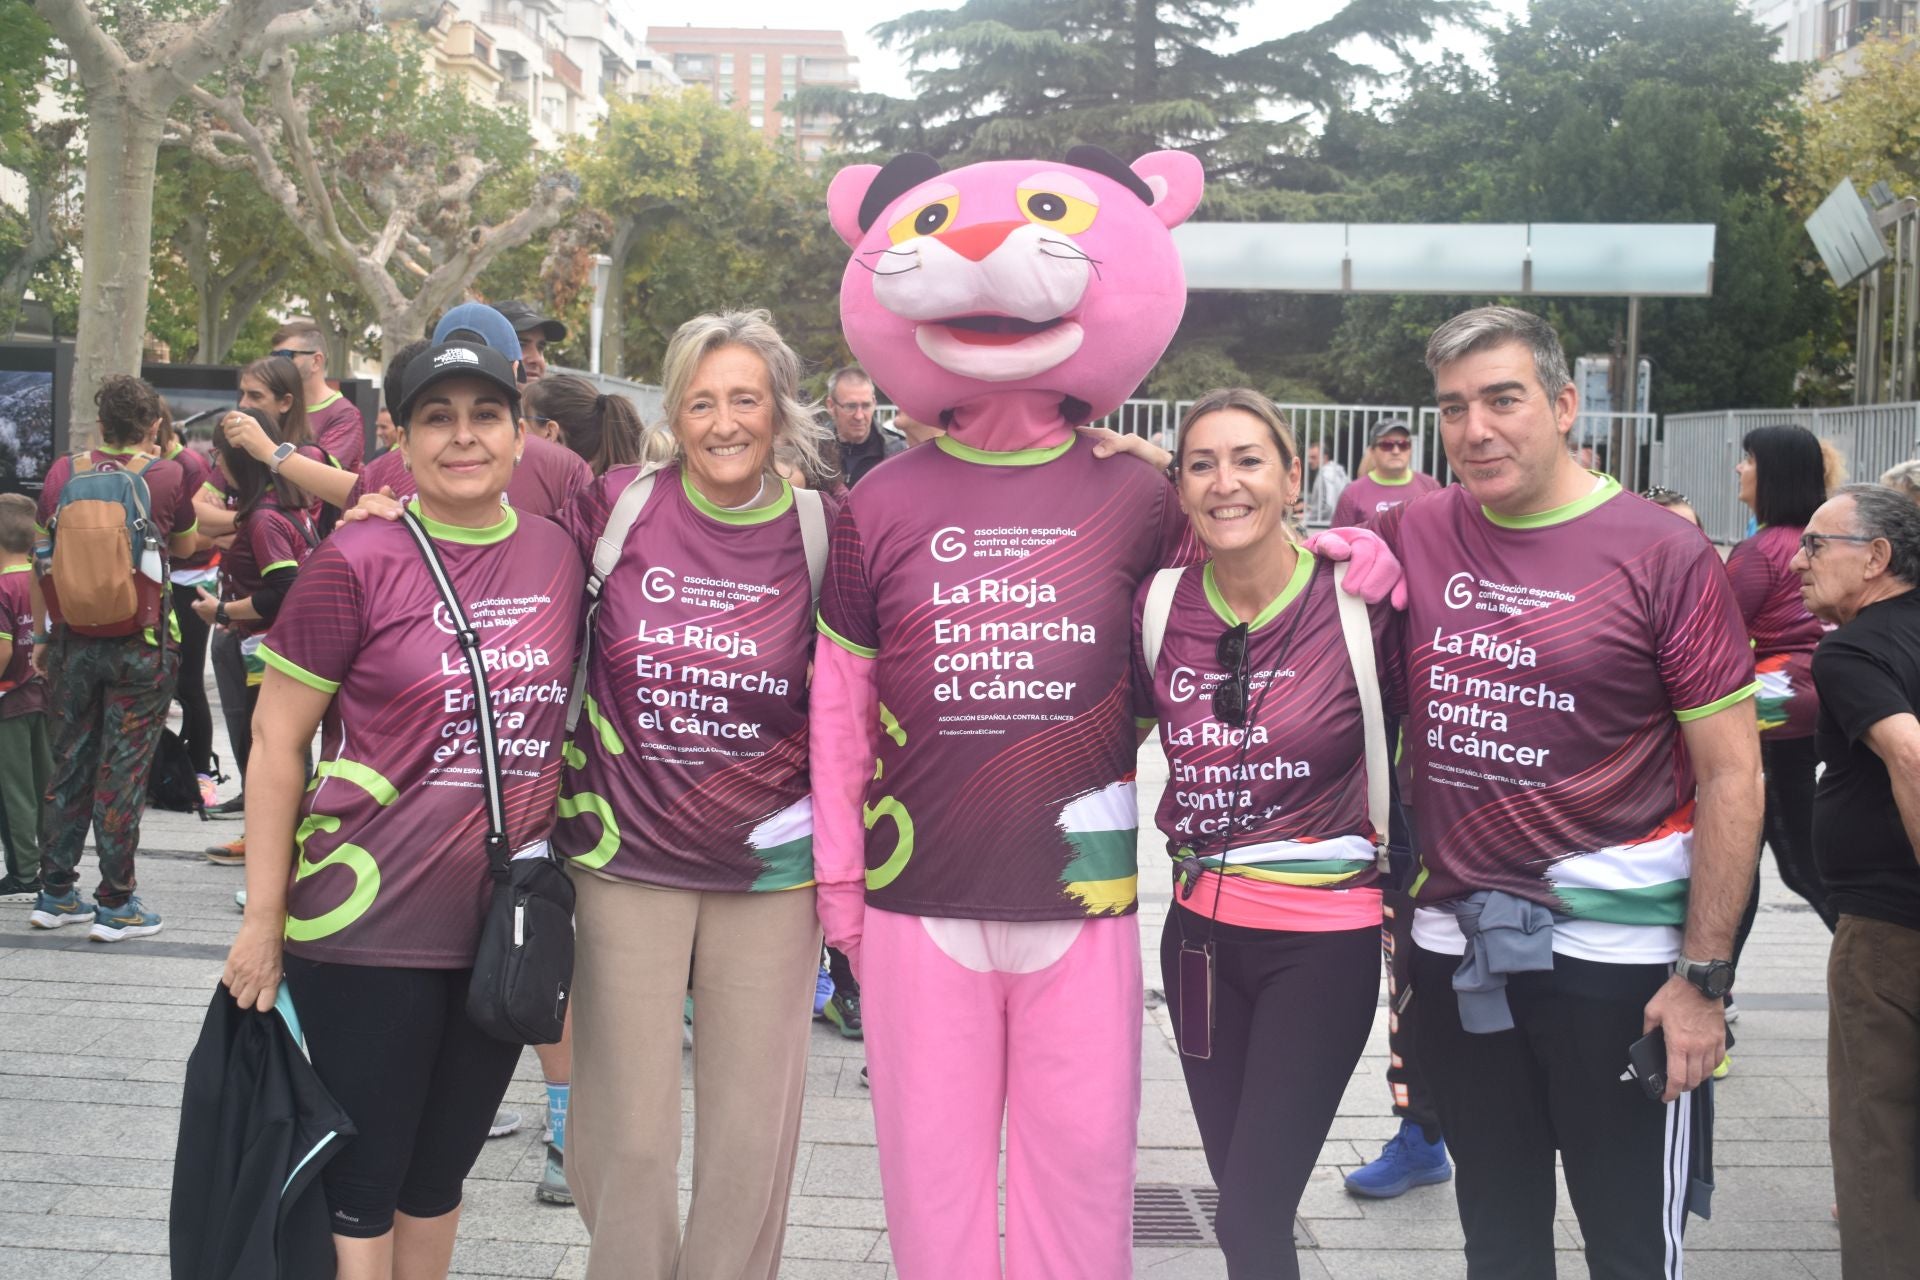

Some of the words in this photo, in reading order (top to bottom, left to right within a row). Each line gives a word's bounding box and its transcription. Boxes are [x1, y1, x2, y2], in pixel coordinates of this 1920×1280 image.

[974, 526, 1029, 536] asociación
[1031, 527, 1077, 537] española
[974, 538, 1008, 546] contra
[1010, 536, 1019, 546] el
[1021, 537, 1057, 546] cáncer
[989, 548, 1002, 557] La
[1004, 547, 1030, 559] Rioja
[681, 585, 715, 597] contra
[716, 588, 726, 598] el
[727, 591, 761, 603] cáncer
[683, 575, 736, 589] asociación
[737, 582, 780, 596] española
[933, 581, 970, 605] La
[980, 578, 1057, 608] Rioja
[1479, 579, 1527, 594] asociación
[1528, 588, 1576, 602] española
[473, 608, 496, 618] ontra
[507, 606, 538, 615] cáncer
[513, 595, 551, 605] española
[680, 597, 694, 605] en
[695, 597, 708, 607] La
[709, 599, 735, 612] Rioja
[1475, 602, 1487, 610] en
[1488, 603, 1498, 612] La
[1499, 603, 1523, 616] Rioja
[1478, 590, 1506, 602] contra
[1506, 594, 1517, 604] el
[1517, 597, 1551, 609] cáncer
[470, 621, 482, 629] en
[482, 620, 494, 628] La
[494, 618, 519, 627] Rioja
[934, 618, 971, 644] En
[980, 616, 1096, 644] marcha
[638, 619, 674, 645] La
[683, 625, 758, 659] Rioja
[1432, 626, 1463, 655] La
[1469, 633, 1537, 670] Rioja
[480, 644, 550, 672] Rioja
[934, 646, 1034, 673] contra
[636, 654, 673, 680] En
[681, 665, 789, 696] marcha
[934, 676, 962, 701] el
[969, 674, 1077, 701] cáncer
[489, 680, 568, 706] marcha
[636, 686, 729, 714] contra
[1429, 664, 1459, 694] En
[1464, 677, 1576, 713] marcha
[637, 709, 664, 731] el
[670, 713, 762, 739] cáncer
[938, 714, 976, 722] ASOCIACIÓN
[977, 712, 1011, 721] ESPAÑOLA
[1049, 714, 1074, 722] CÁNCER
[1427, 700, 1508, 733] contra
[1167, 721, 1194, 746] La
[1427, 724, 1445, 750] el
[1449, 731, 1550, 767] cáncer
[463, 738, 551, 758] cncer
[1173, 758, 1198, 783] En
[1204, 756, 1311, 784] marcha
